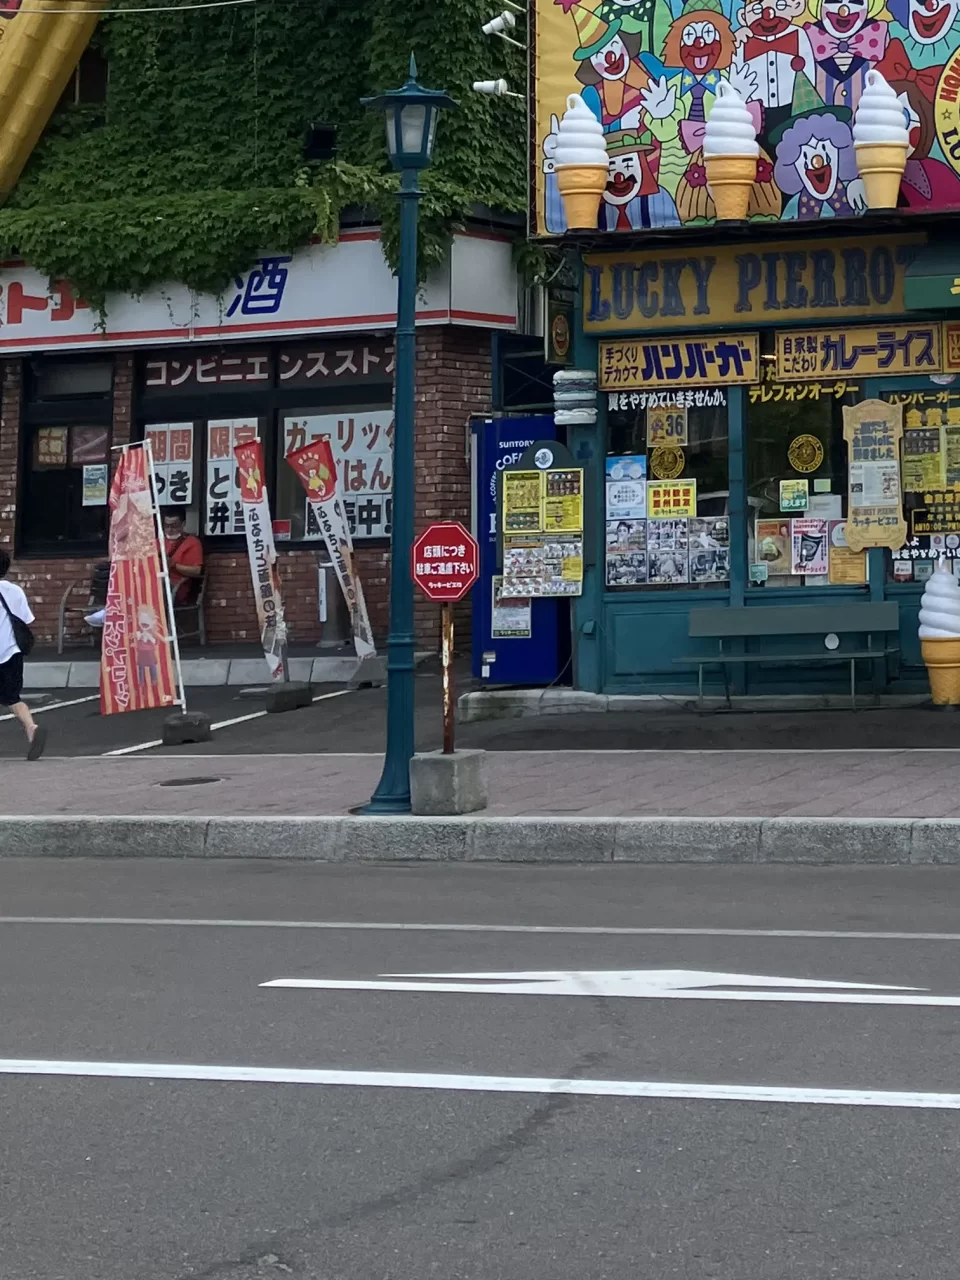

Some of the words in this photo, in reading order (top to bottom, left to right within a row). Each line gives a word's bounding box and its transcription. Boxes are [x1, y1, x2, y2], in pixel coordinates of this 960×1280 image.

[226, 256, 292, 318] 酒
[586, 255, 717, 322] LUCKY
[605, 346, 638, 364] 手づくり
[783, 335, 818, 355] 自家製
[820, 329, 935, 372] カレーライス
[641, 340, 752, 381] ハンバーガー
[783, 354, 818, 373] こだわり
[604, 366, 639, 384] デカウマ
[666, 414, 684, 437] 36
[499, 440, 535, 448] SUNTORY
